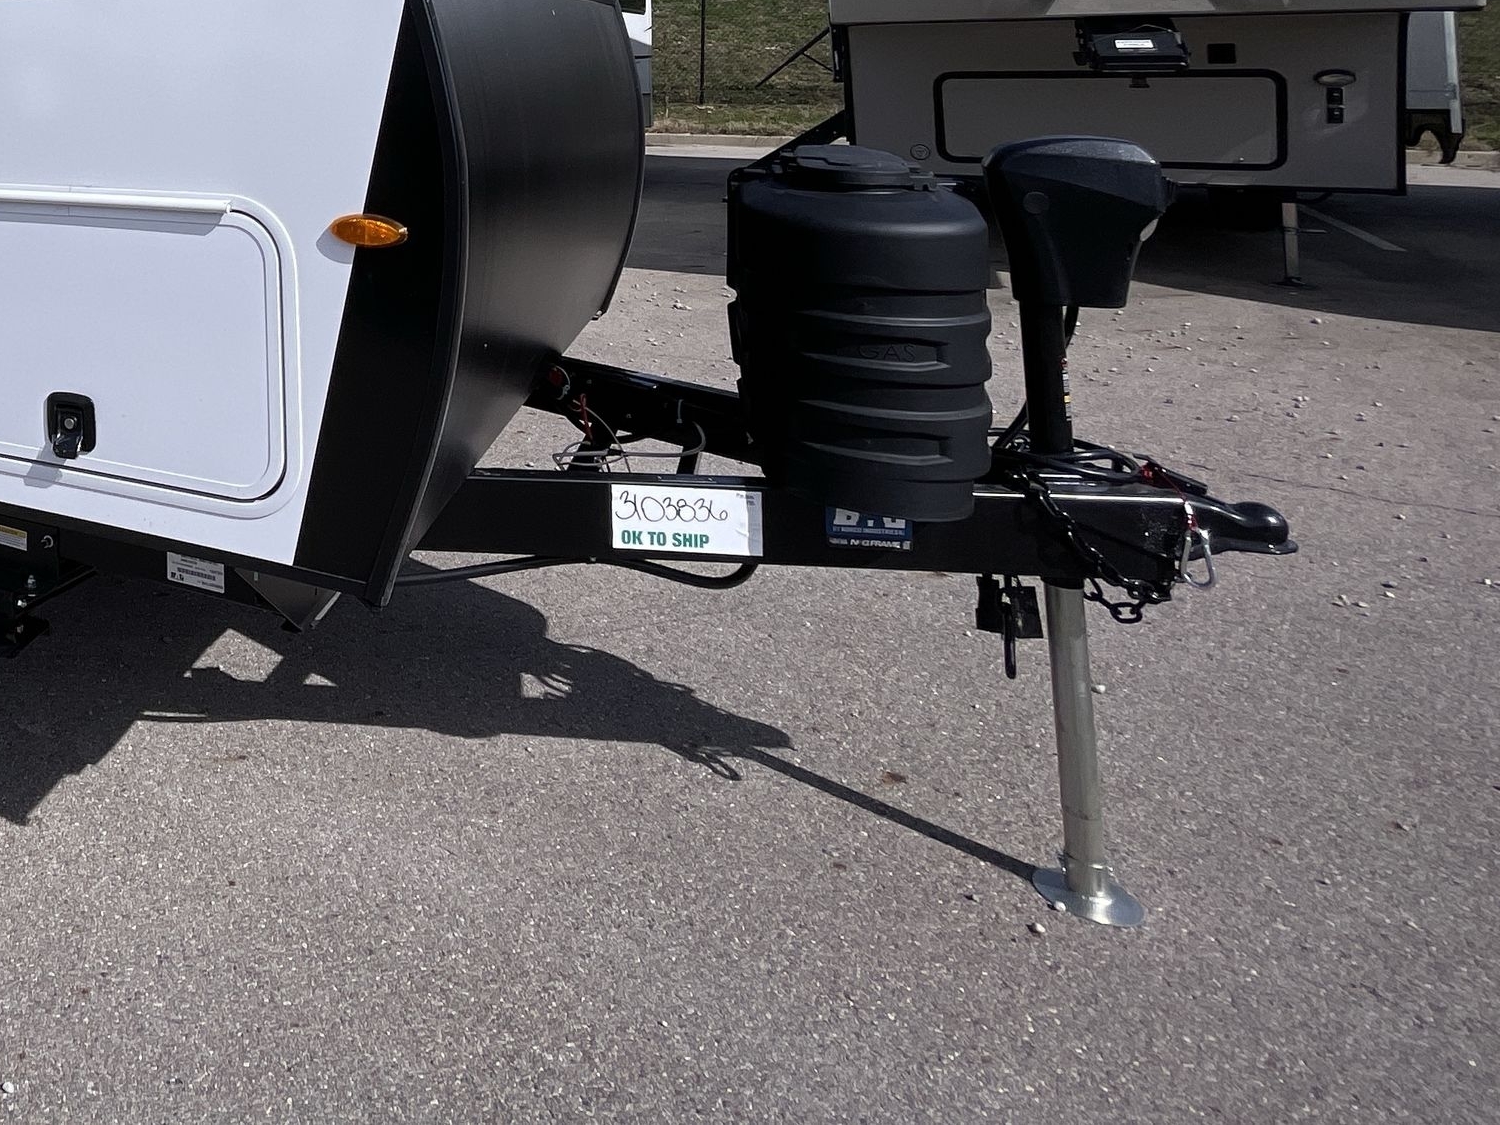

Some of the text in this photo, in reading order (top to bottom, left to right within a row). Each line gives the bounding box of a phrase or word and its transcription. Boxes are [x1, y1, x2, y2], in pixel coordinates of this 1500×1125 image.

[858, 343, 917, 362] GAS
[614, 490, 729, 523] 3103836
[621, 529, 710, 549] OK TO SHIP
